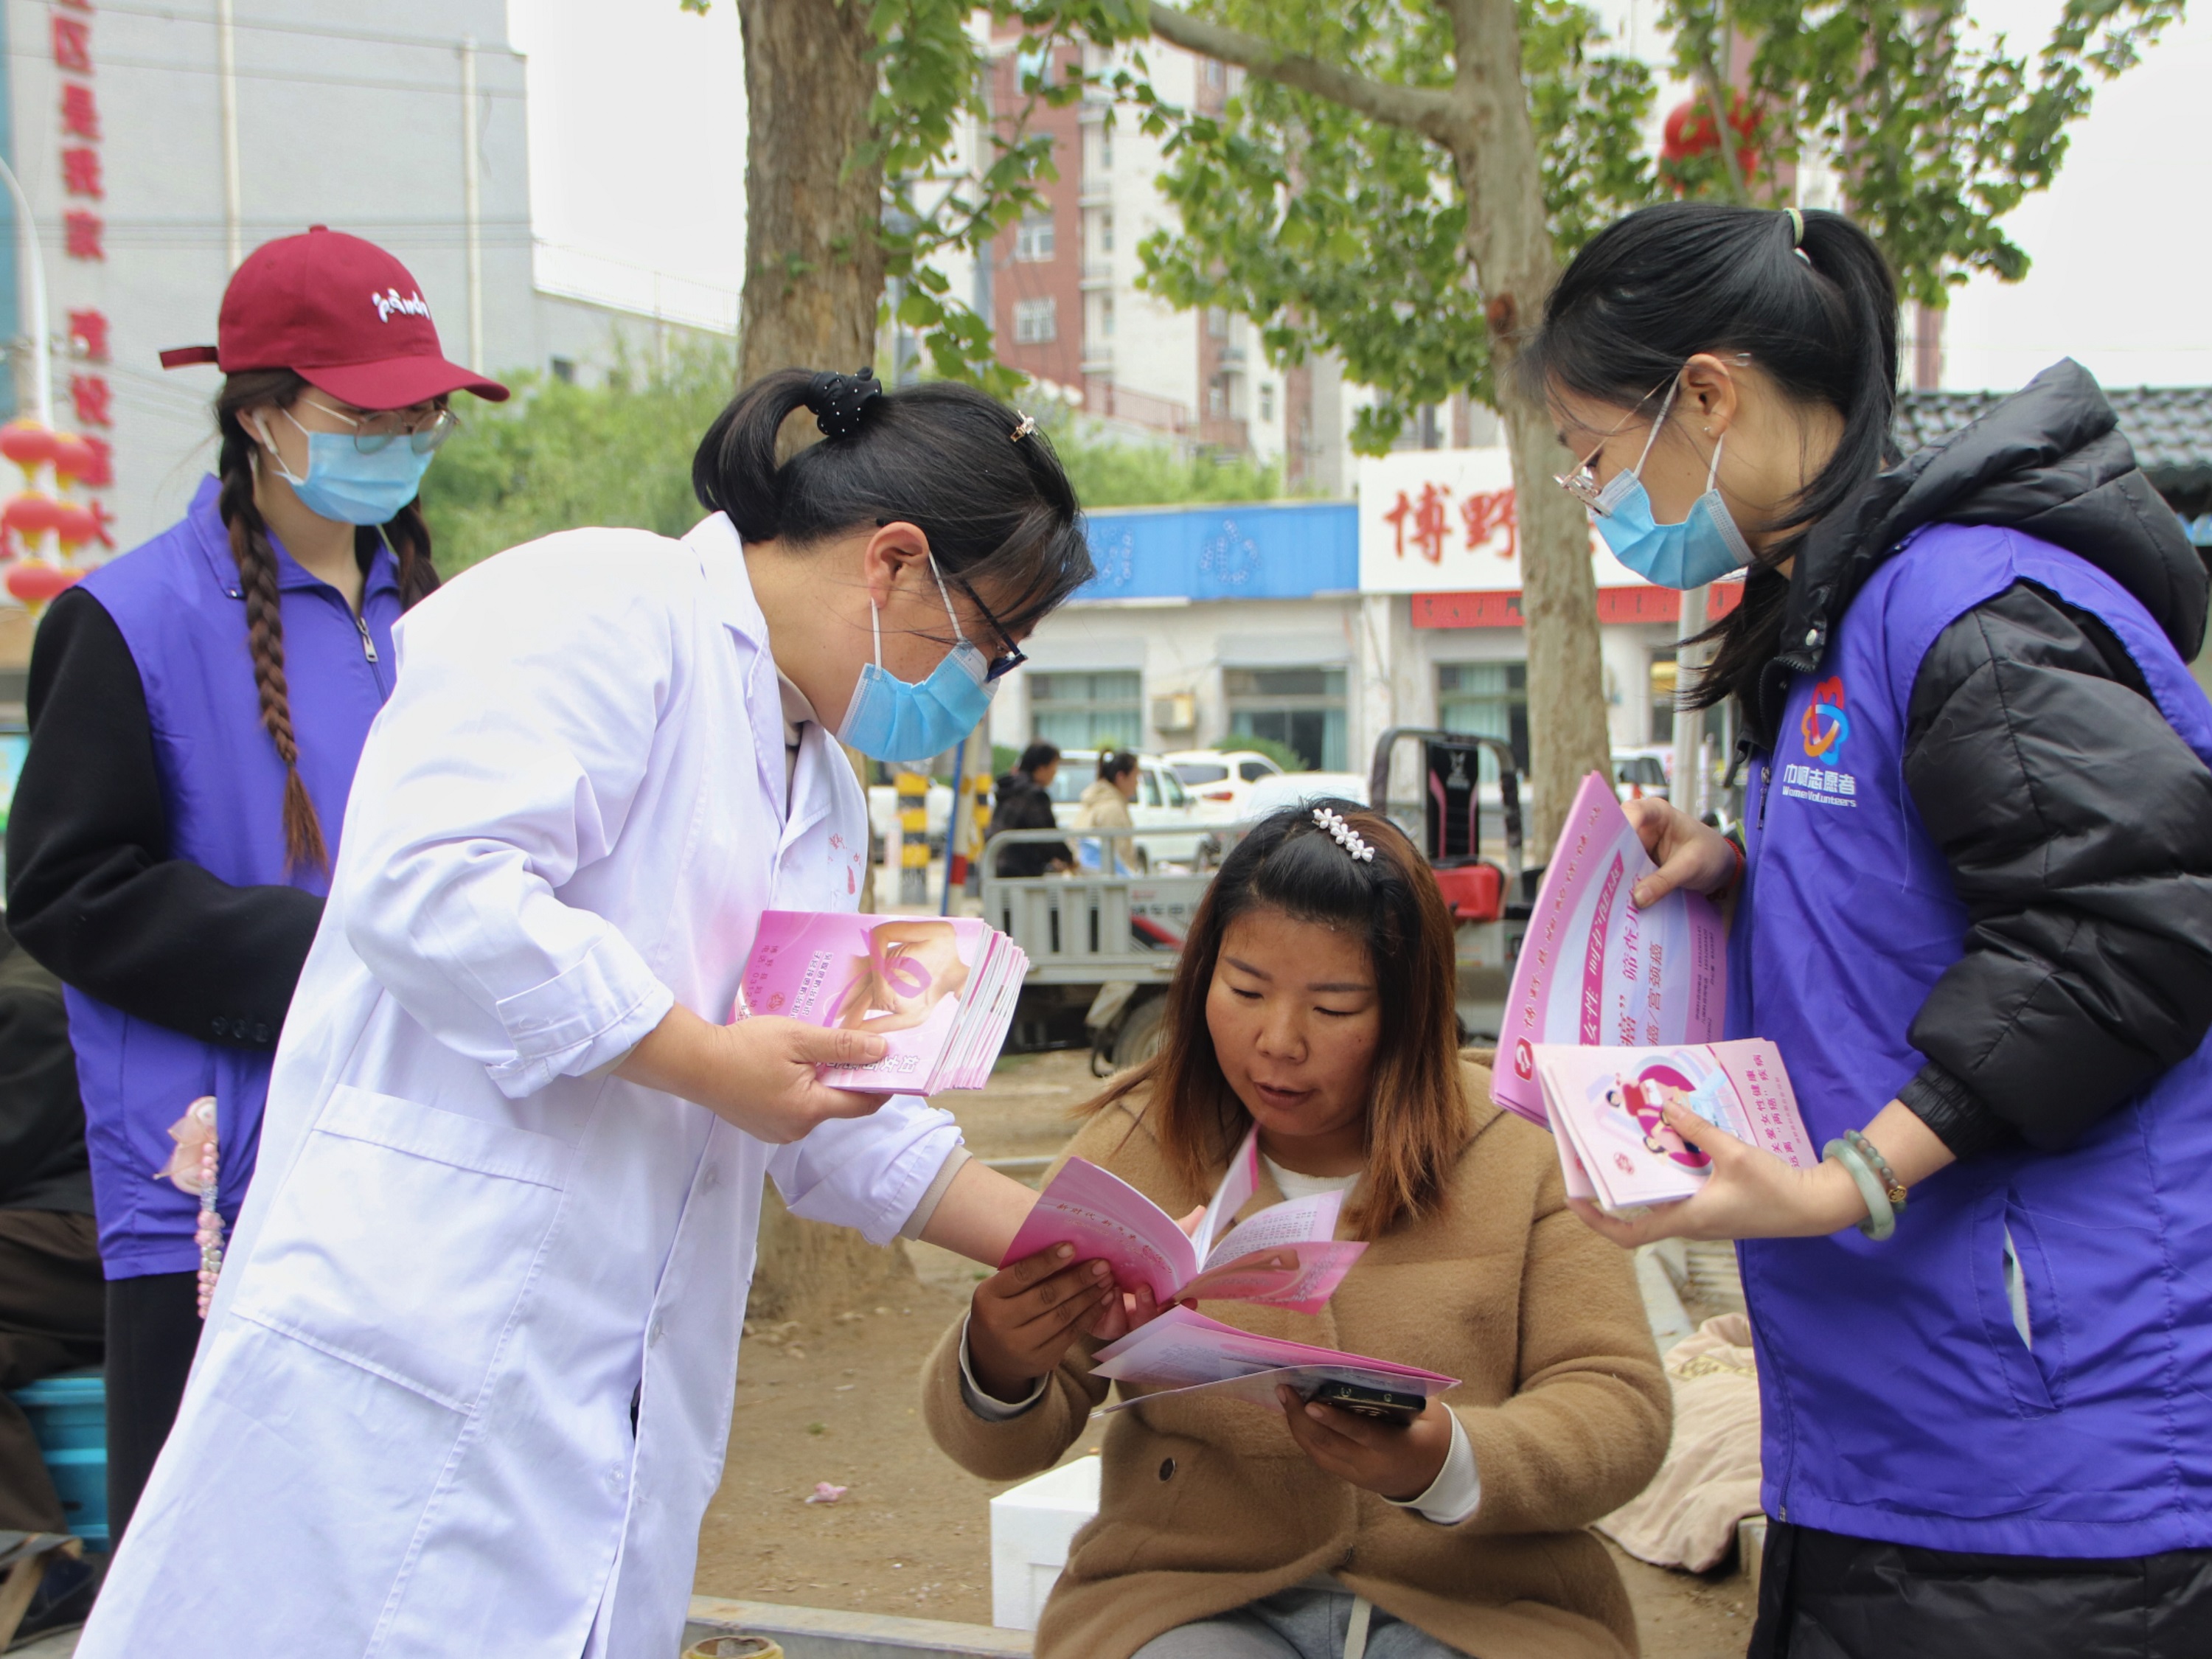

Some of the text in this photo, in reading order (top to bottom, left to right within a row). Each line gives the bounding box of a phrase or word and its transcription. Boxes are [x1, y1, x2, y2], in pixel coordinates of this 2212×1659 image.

[52, 0, 104, 262] 区是我家
[1382, 481, 1517, 565] 博野
[1783, 763, 1855, 796] 巾帼志愿者
[1582, 986, 1599, 1047] 女性
